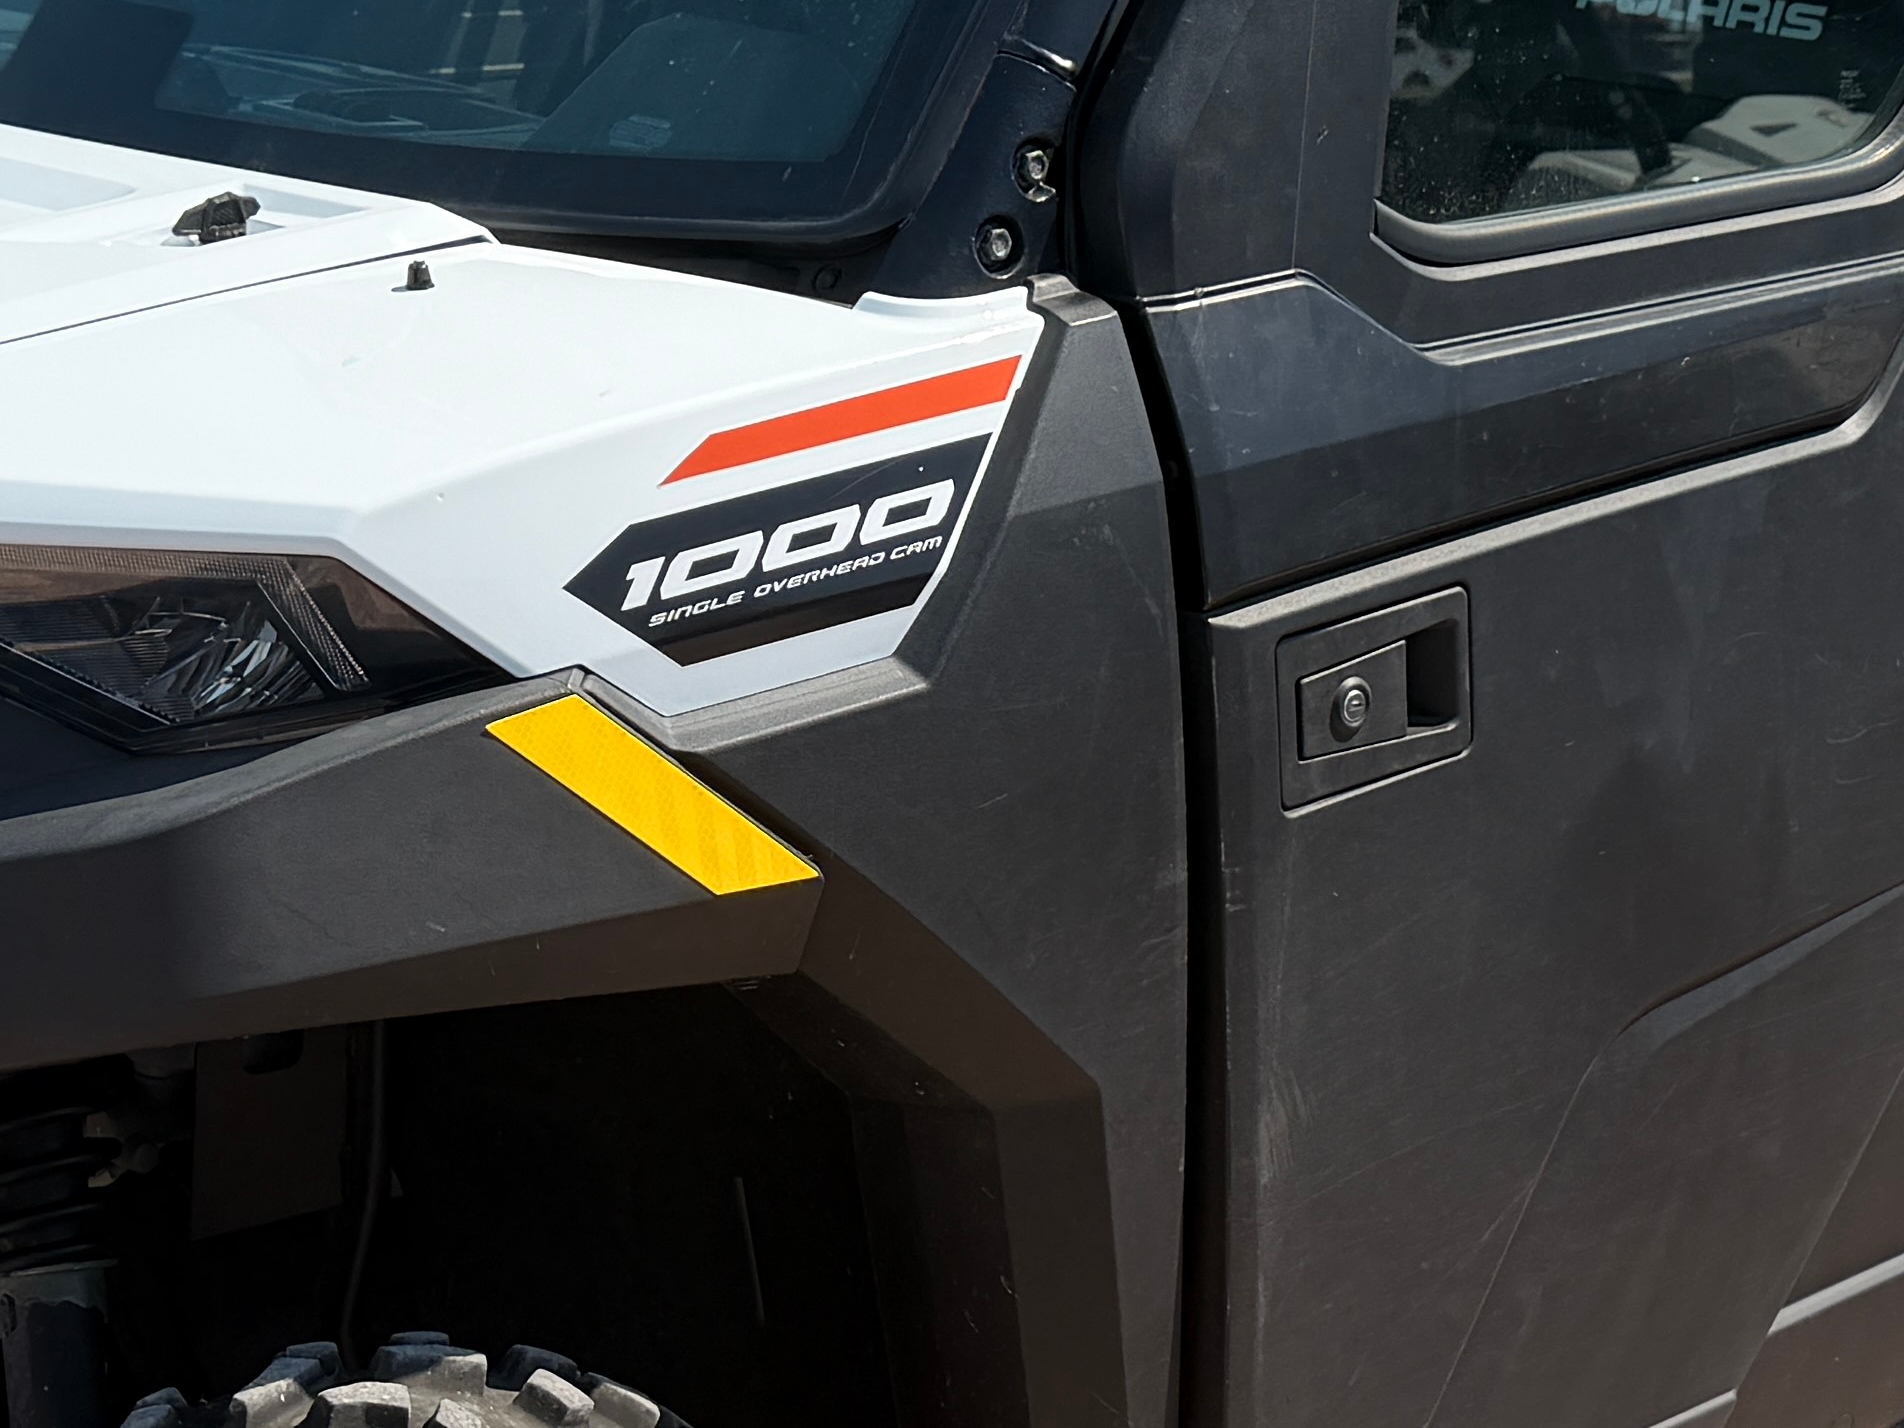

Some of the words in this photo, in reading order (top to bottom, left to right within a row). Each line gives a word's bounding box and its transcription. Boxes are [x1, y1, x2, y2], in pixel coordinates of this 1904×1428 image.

[621, 479, 955, 611] 1000
[648, 591, 745, 627] SINGLE
[753, 552, 885, 597] OVERHEAD
[890, 535, 943, 567] CAM
